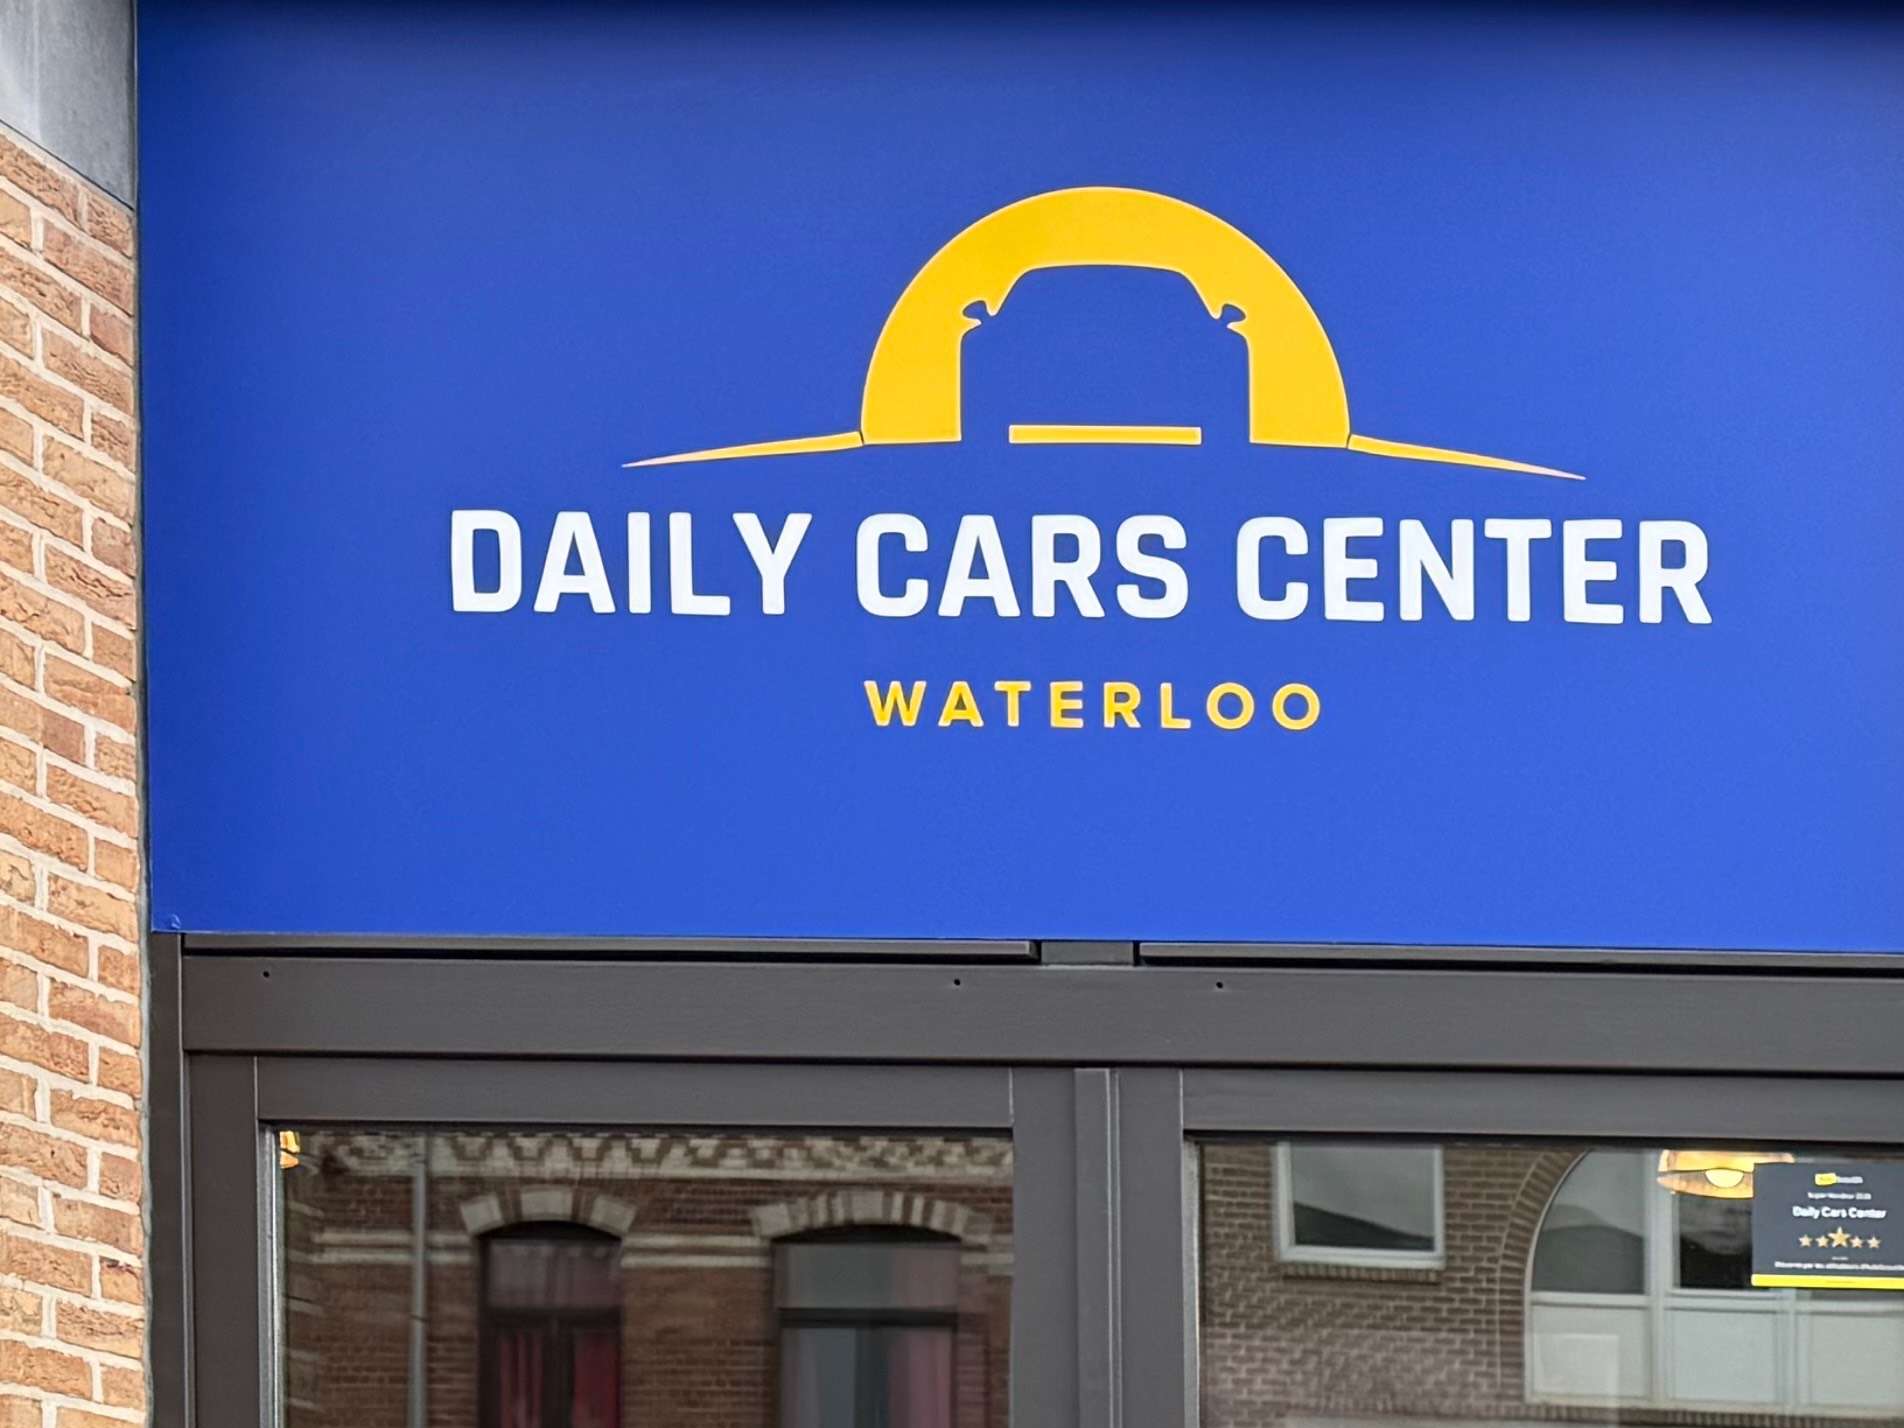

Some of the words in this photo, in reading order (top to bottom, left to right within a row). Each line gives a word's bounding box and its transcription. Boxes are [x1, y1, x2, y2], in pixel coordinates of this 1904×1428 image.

[450, 509, 812, 616] DAILY
[856, 512, 1189, 619] CARS
[1236, 516, 1713, 625] CENTER
[864, 679, 1322, 731] WATERLOO
[1792, 1205, 1820, 1219] Daily
[1821, 1206, 1847, 1218] Cars
[1848, 1207, 1887, 1218] Center
